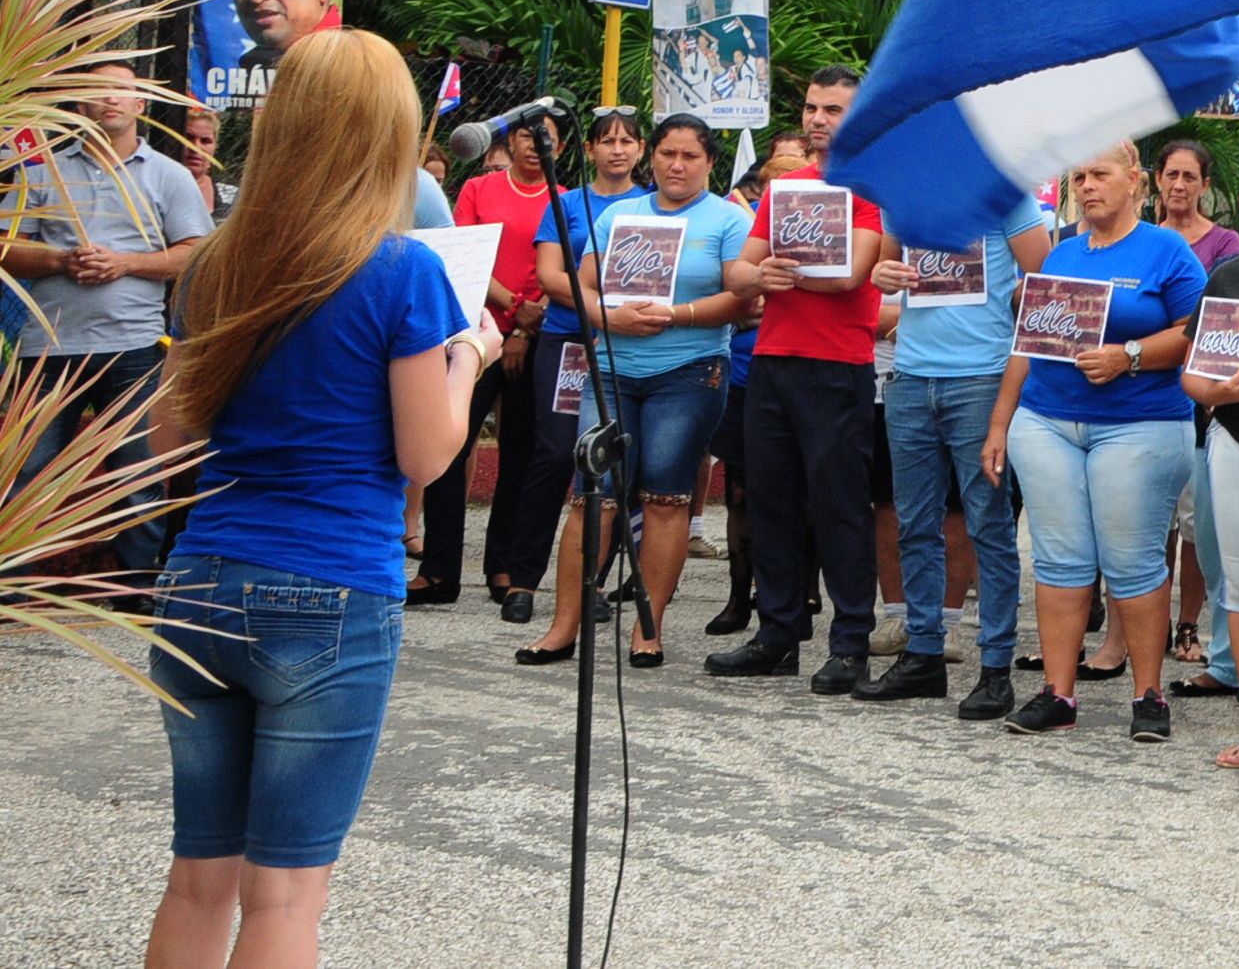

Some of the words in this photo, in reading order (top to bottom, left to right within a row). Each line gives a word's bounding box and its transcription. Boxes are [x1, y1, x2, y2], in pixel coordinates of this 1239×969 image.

[779, 203, 833, 246] tú,
[612, 234, 673, 287] Yo,
[1025, 300, 1083, 339] ella,
